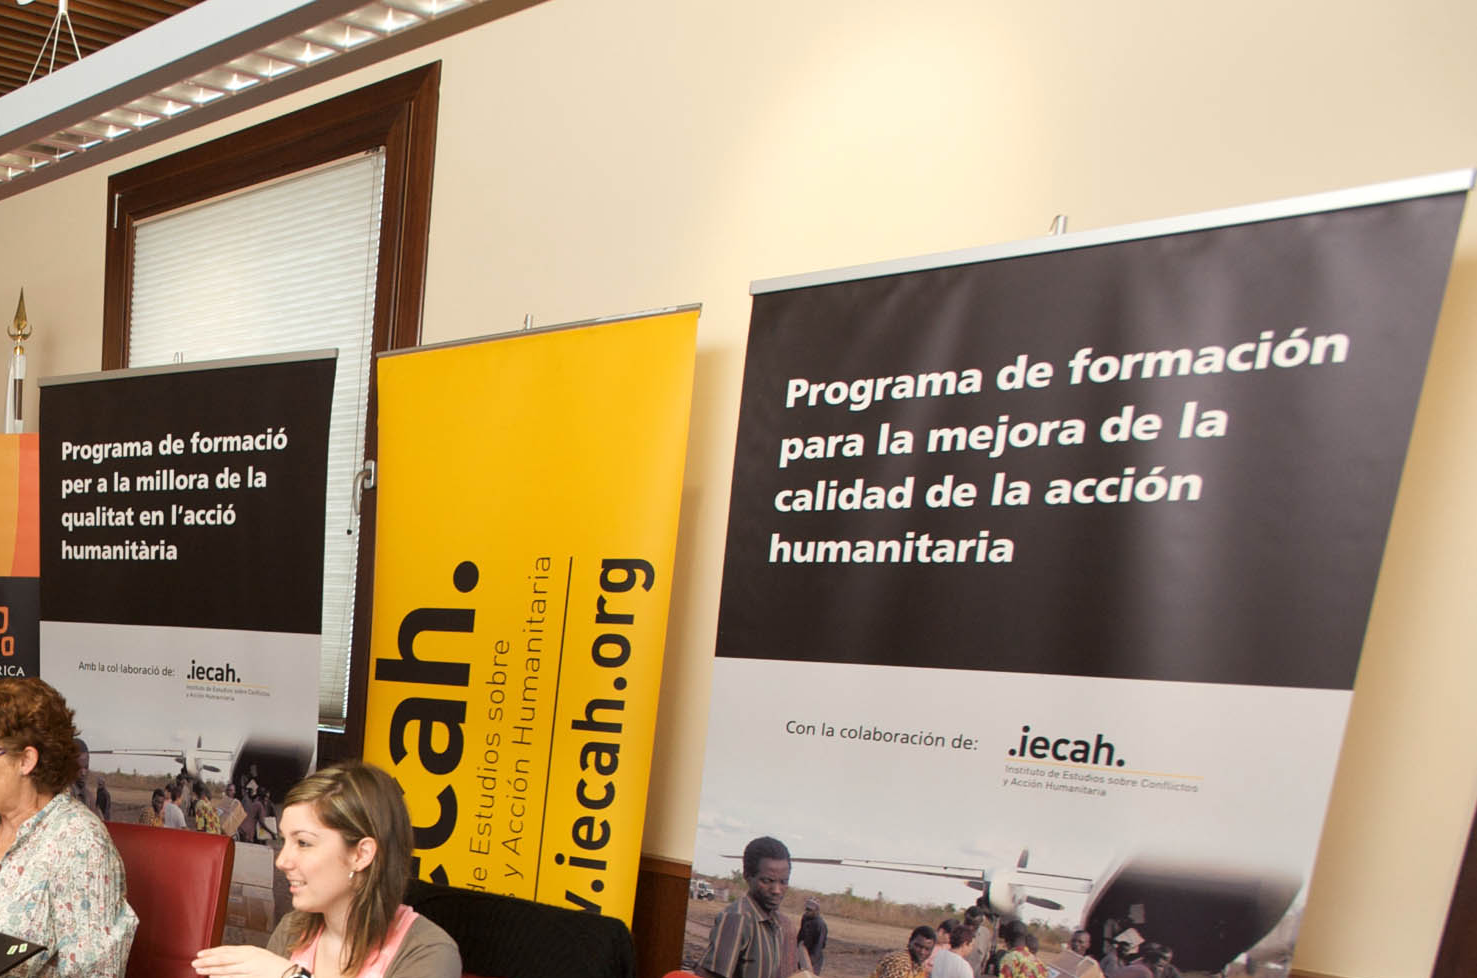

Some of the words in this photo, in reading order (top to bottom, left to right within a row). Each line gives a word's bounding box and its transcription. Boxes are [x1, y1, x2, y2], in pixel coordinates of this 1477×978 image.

[786, 369, 982, 411] Programa
[997, 355, 1053, 390] de
[1069, 328, 1350, 384] formación
[62, 441, 152, 464] Programa
[159, 434, 184, 455] de
[190, 428, 287, 453] formació
[780, 434, 864, 468] para
[878, 423, 913, 454] la
[928, 415, 1085, 457] mejora
[1101, 407, 1163, 442] de
[1179, 401, 1227, 438] la
[62, 479, 92, 498] per
[97, 478, 107, 492] a
[114, 472, 130, 492] la
[137, 469, 208, 491] millora
[216, 467, 241, 488] de
[248, 466, 266, 487] la
[775, 477, 914, 512] calidad
[926, 475, 977, 507] de
[992, 473, 1030, 505] la
[1045, 466, 1203, 504] acción
[62, 507, 134, 531] qualitat
[140, 511, 164, 525] en
[172, 504, 236, 525] l'acció
[62, 540, 177, 560] humanitària
[769, 531, 1014, 563] humanitaria
[512, 556, 551, 746] Humanitaria
[187, 660, 240, 683] .iecah.
[469, 733, 501, 855] Estudios
[485, 639, 511, 721] sobre
[785, 720, 817, 736] Con
[821, 723, 835, 738] la
[839, 724, 946, 748] colaboración
[950, 734, 978, 751] de:
[1009, 726, 1124, 767] .iecah.
[502, 758, 531, 857] Acción
[503, 863, 524, 880] y
